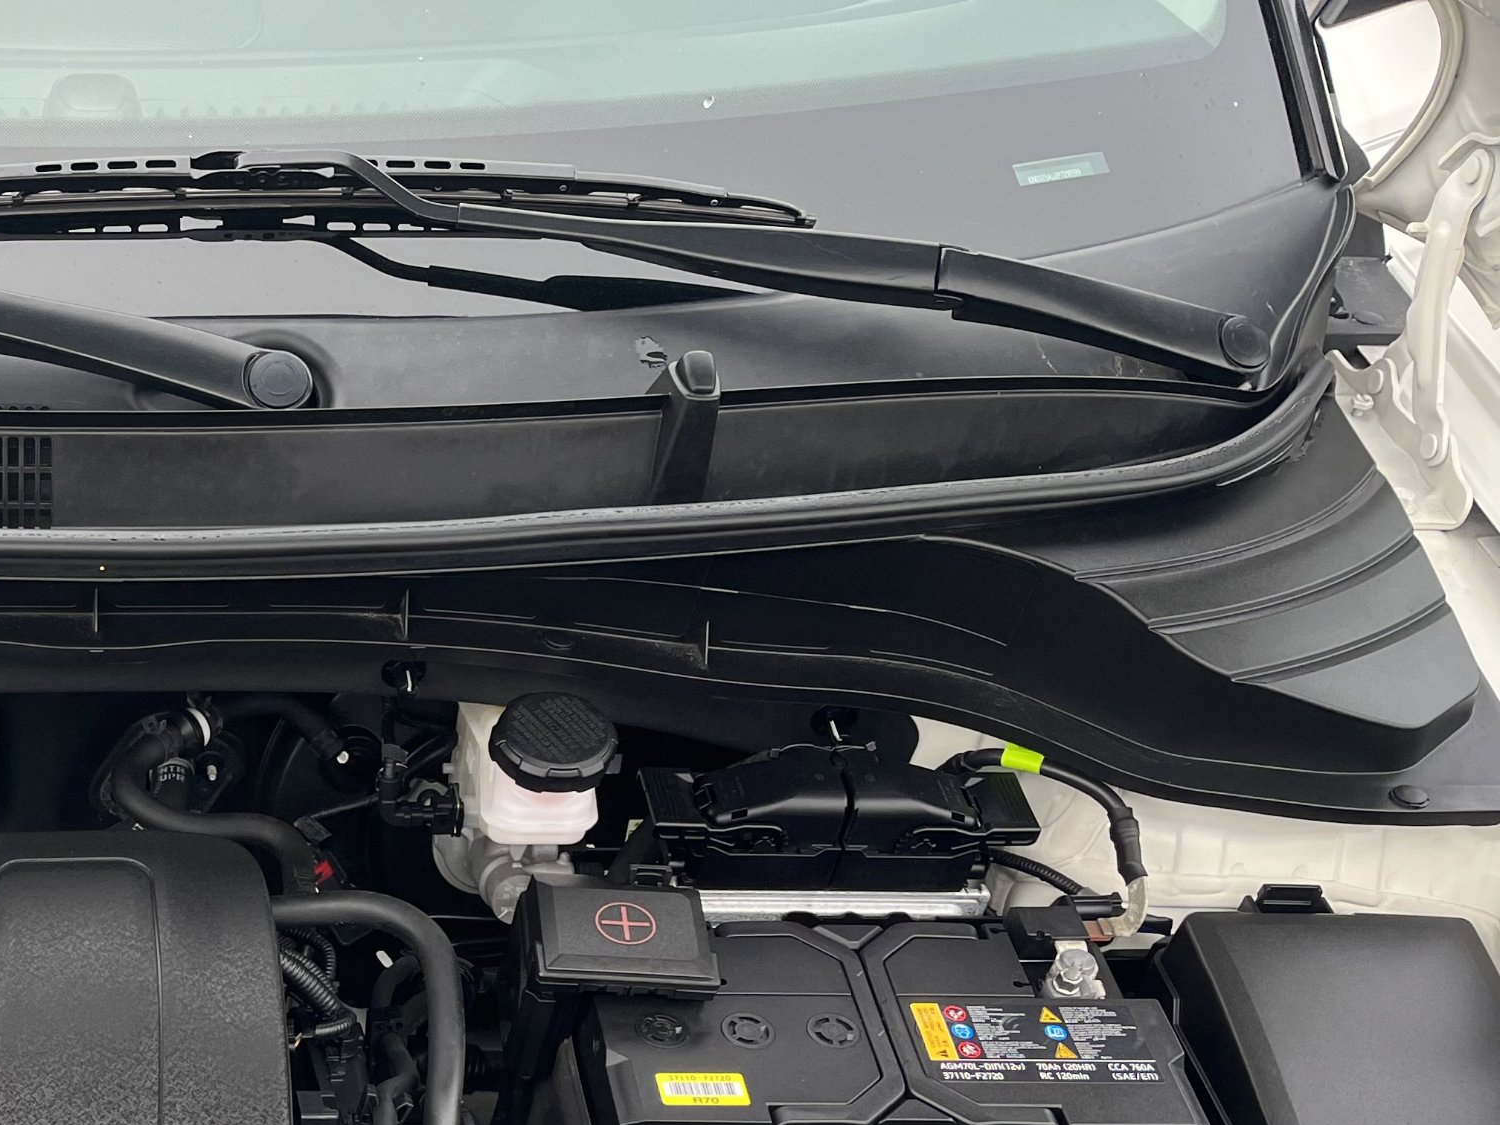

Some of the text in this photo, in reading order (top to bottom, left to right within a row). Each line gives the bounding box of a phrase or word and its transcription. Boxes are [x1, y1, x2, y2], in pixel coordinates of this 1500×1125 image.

[1035, 1062, 1061, 1070] 70Ah
[1062, 1062, 1096, 1071] (20HR)
[1107, 1063, 1127, 1071] CCA
[1128, 1063, 1156, 1071] 760A
[943, 1072, 1004, 1080] 37110-F2720
[1039, 1072, 1054, 1080] RC
[1055, 1072, 1090, 1080] 120min
